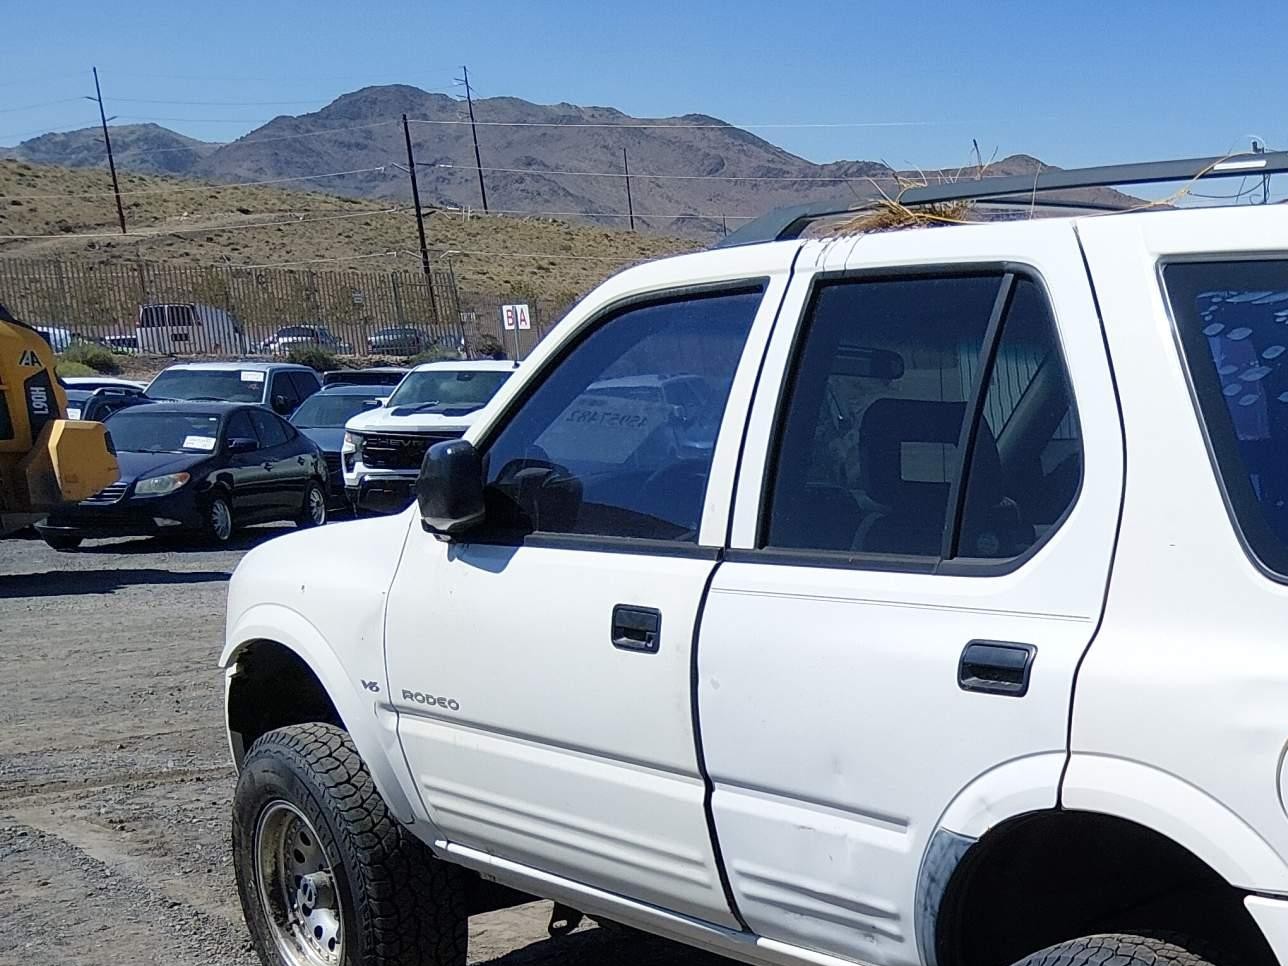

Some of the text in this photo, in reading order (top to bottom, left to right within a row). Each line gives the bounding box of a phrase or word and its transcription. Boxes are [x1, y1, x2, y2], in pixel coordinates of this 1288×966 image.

[506, 307, 527, 326] B A
[367, 437, 425, 448] CHEVR
[360, 679, 380, 693] V6
[401, 688, 460, 711] RODEO
